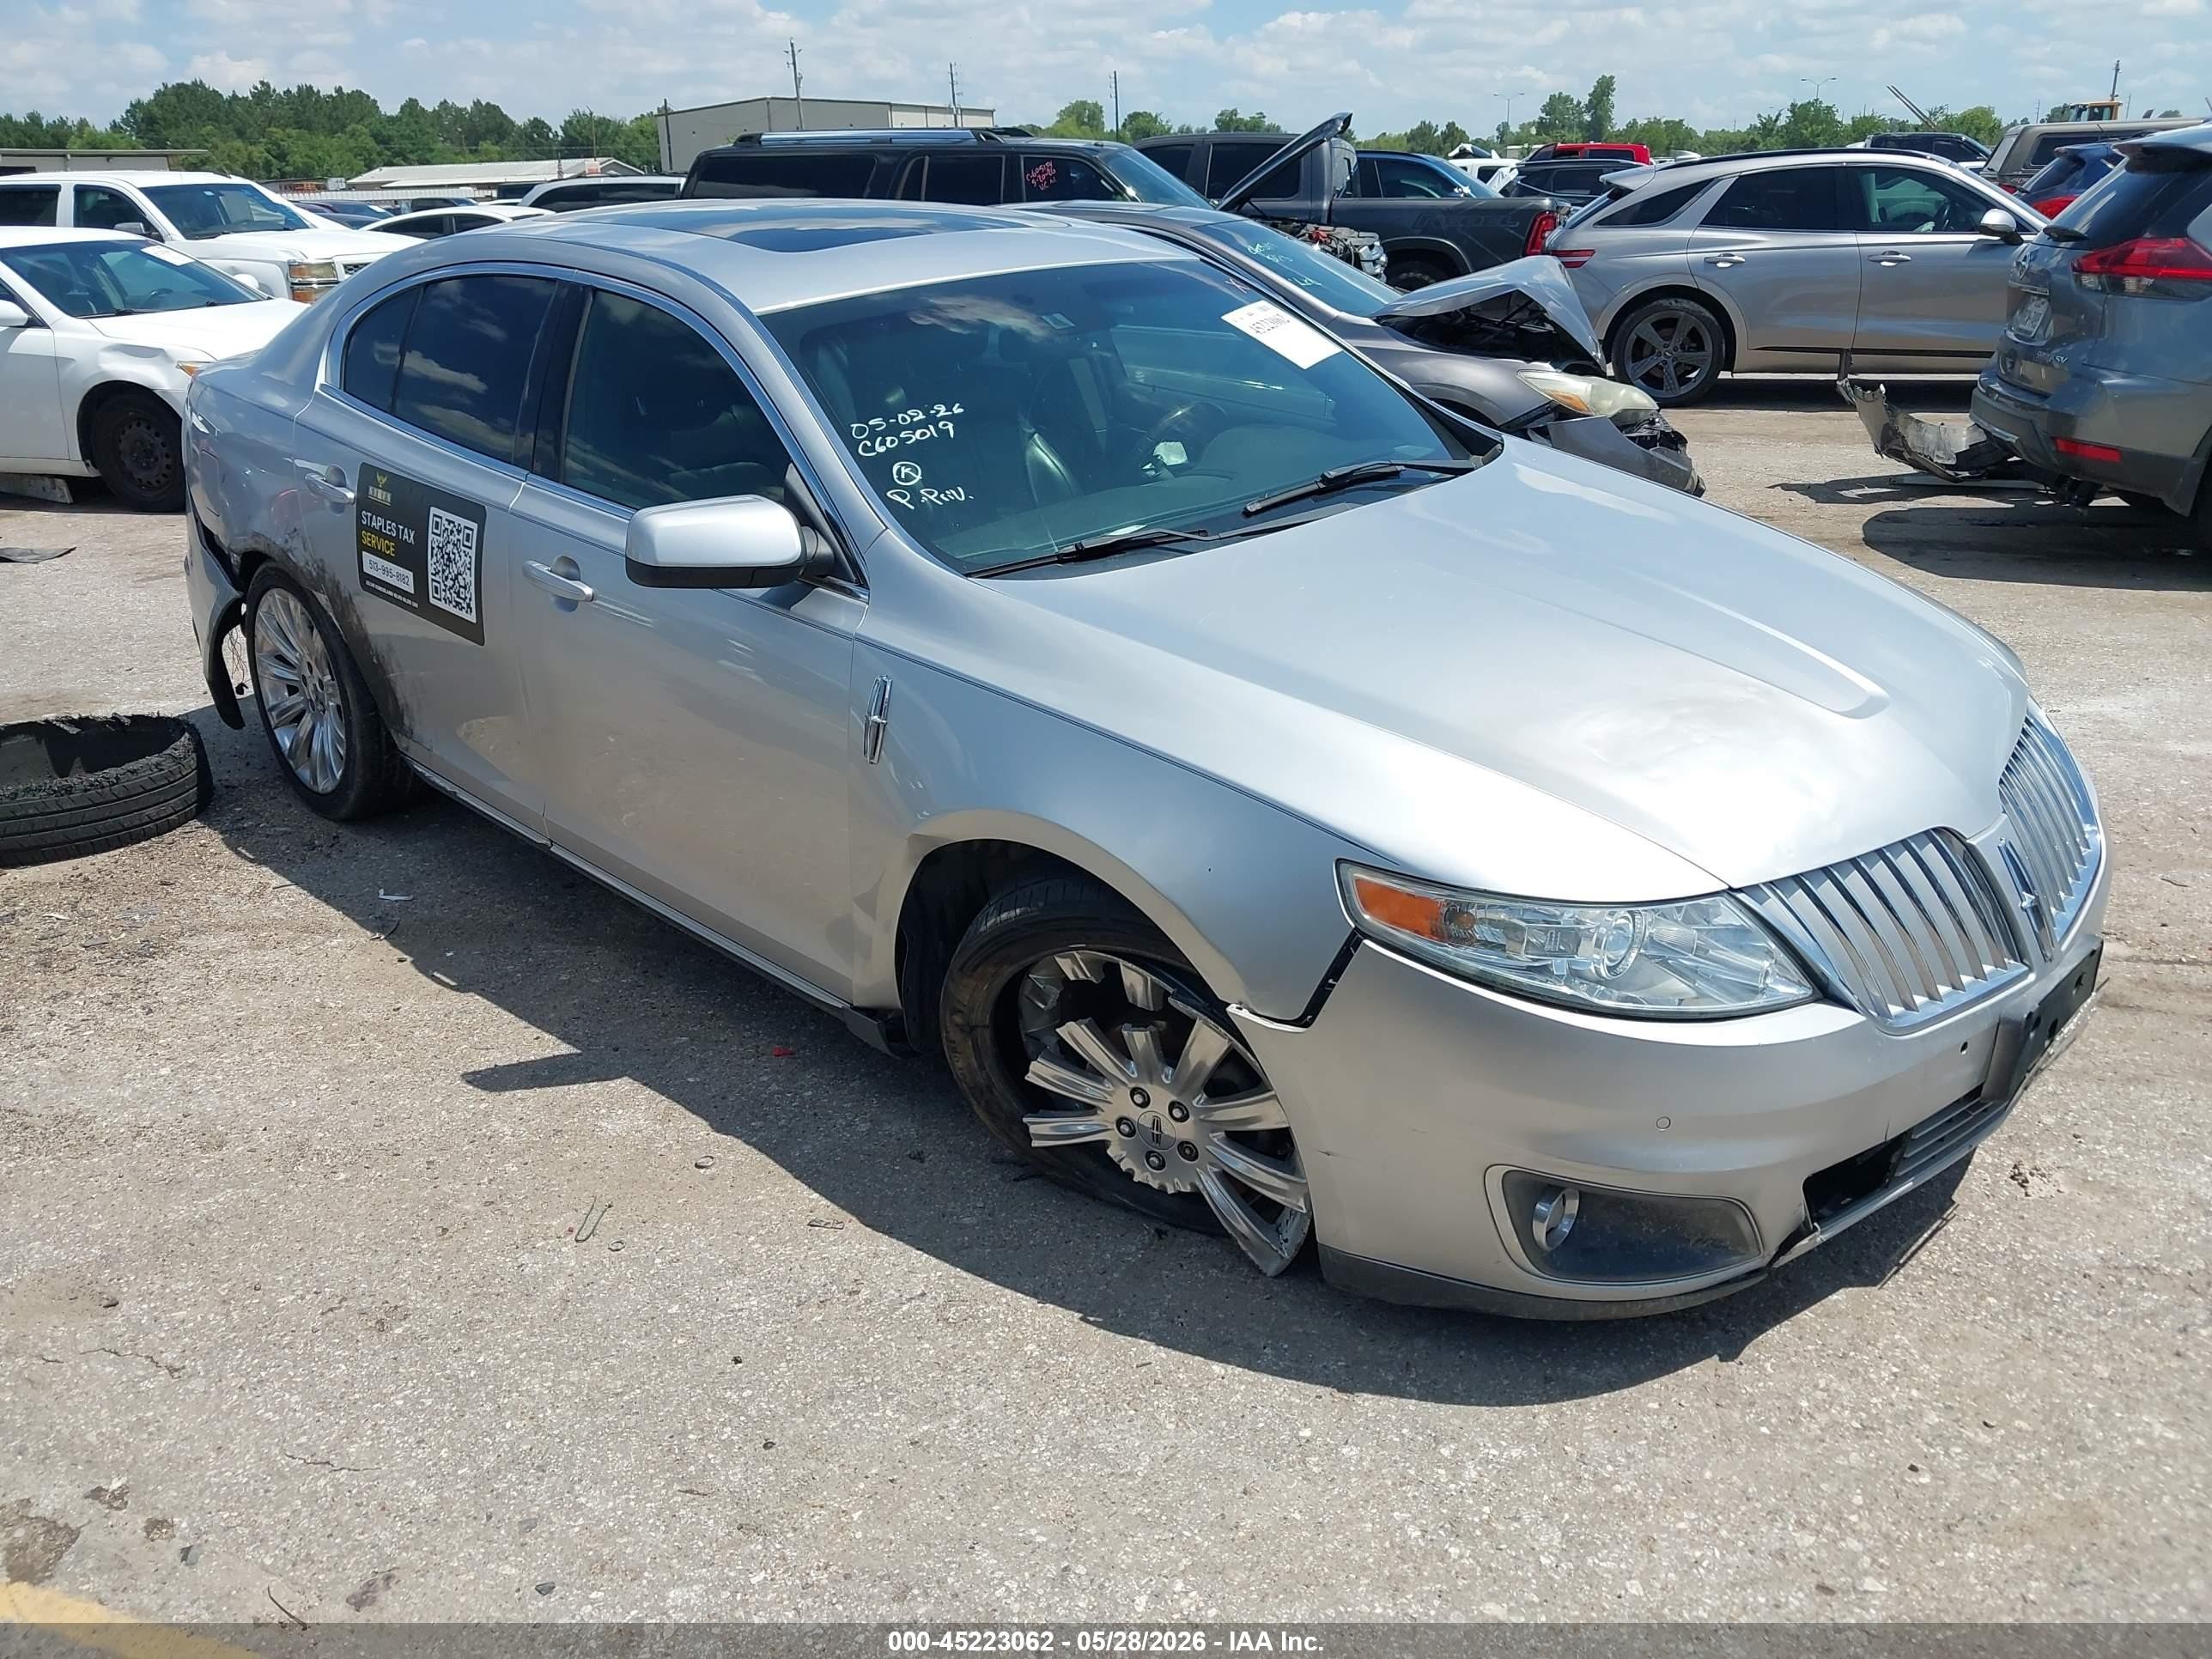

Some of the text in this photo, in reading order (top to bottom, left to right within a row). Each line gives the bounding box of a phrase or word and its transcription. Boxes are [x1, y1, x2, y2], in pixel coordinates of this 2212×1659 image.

[858, 421, 954, 456] C605019
[362, 510, 416, 544] STAPLES TAX
[362, 530, 395, 556] SERVICE
